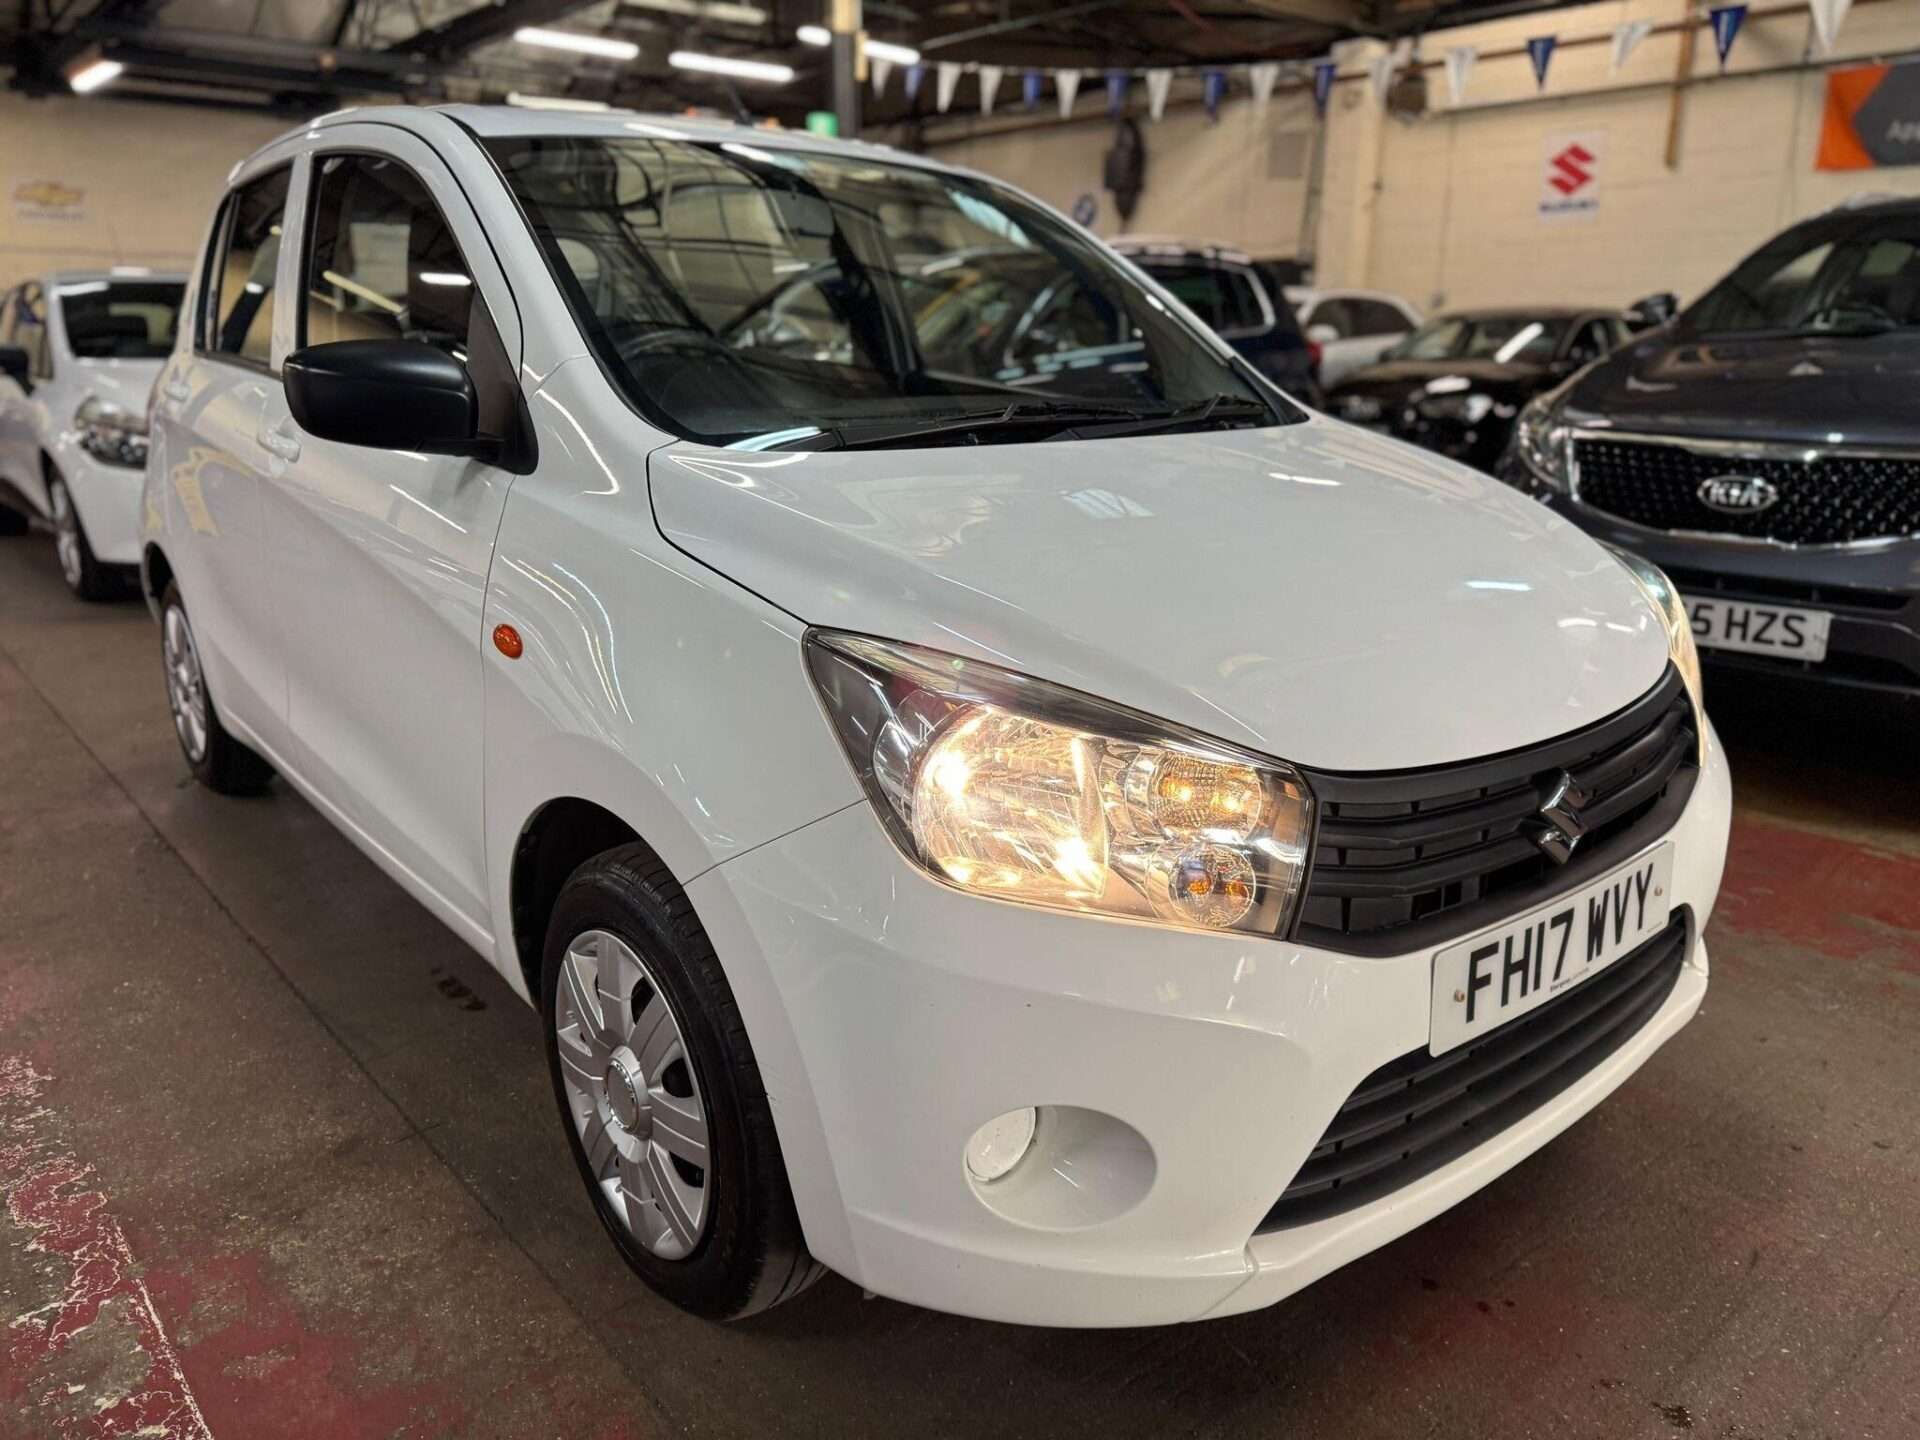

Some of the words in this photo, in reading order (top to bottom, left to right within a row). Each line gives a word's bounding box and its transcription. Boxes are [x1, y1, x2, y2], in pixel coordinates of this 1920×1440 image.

[1710, 482, 1759, 506] KIA
[1682, 604, 1713, 636] 5
[1724, 607, 1807, 648] HZS
[1466, 908, 1575, 1024] FH17
[1587, 862, 1654, 962] WVY
